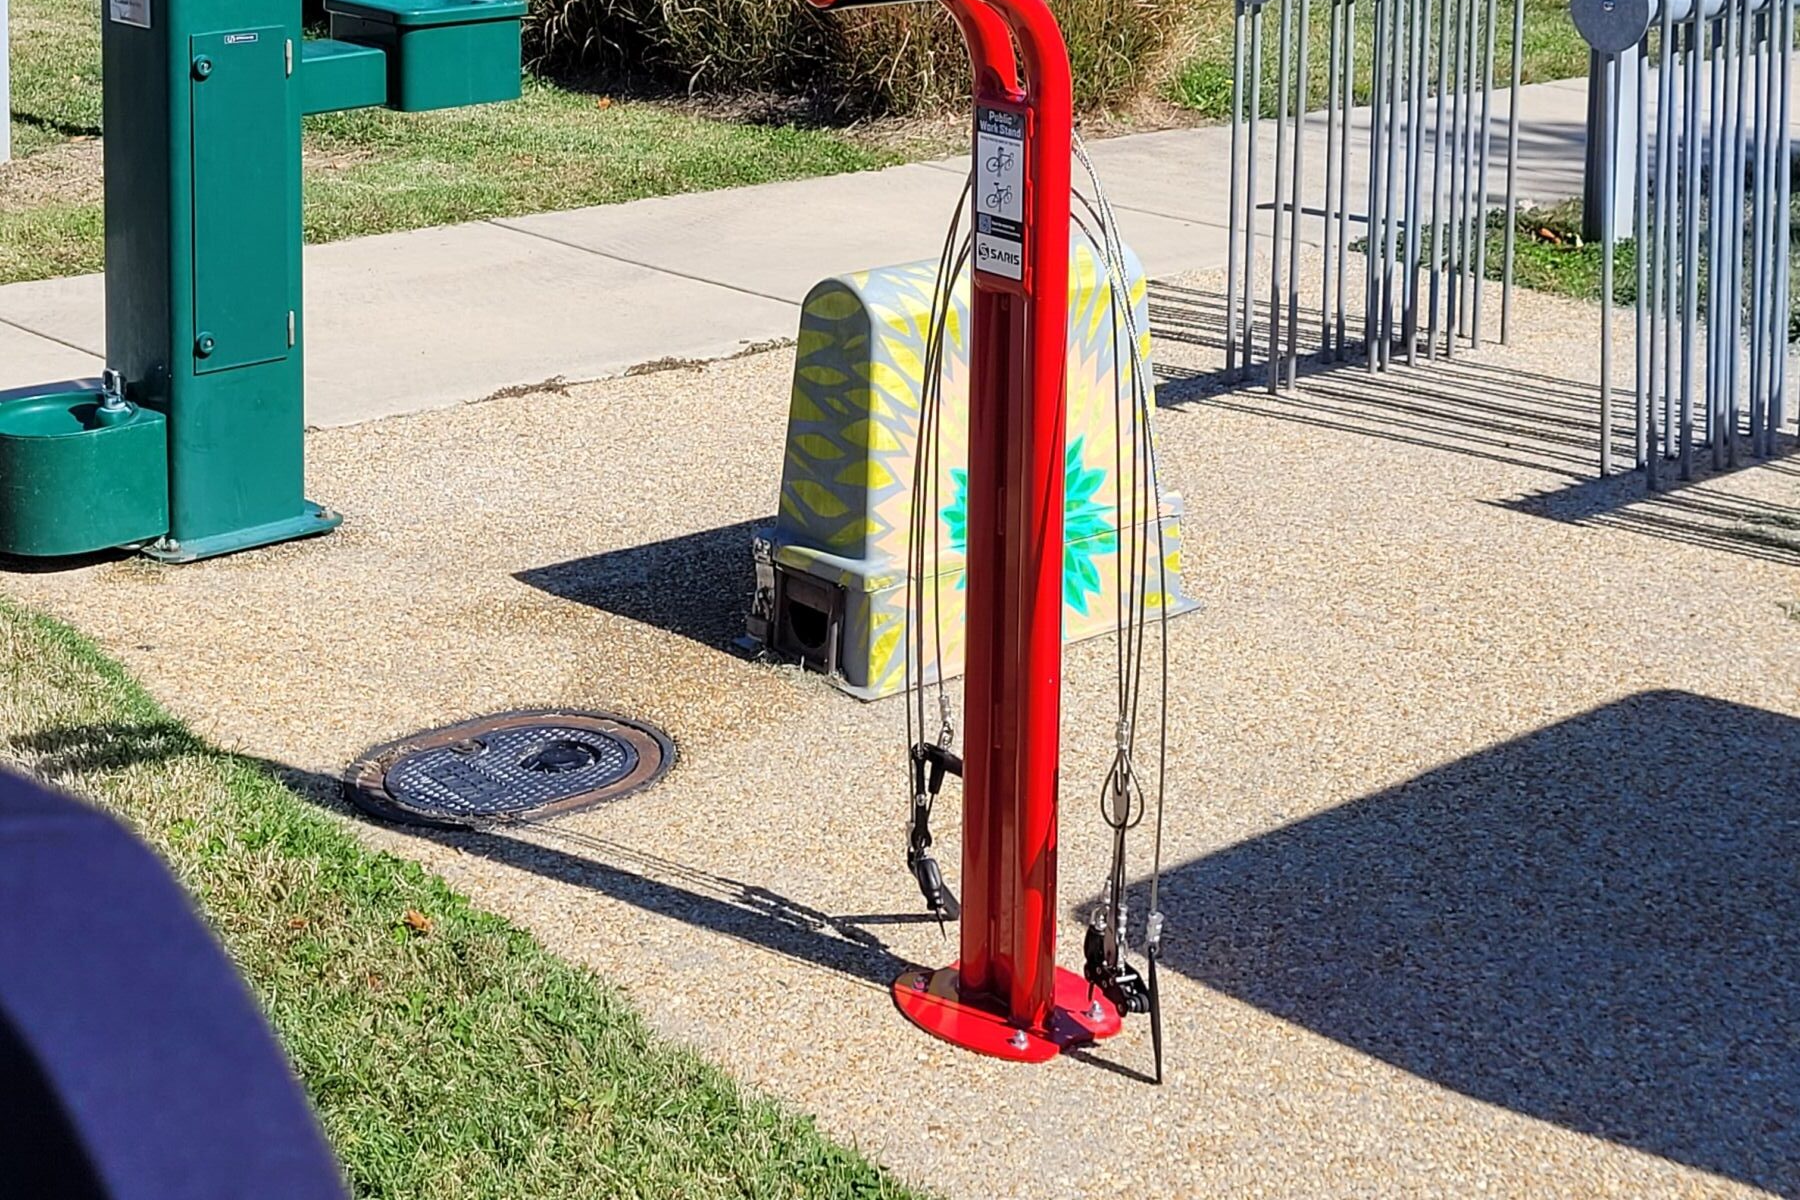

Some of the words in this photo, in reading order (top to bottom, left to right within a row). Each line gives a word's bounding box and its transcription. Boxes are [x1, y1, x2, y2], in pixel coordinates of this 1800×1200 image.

[989, 110, 1012, 125] Public
[979, 119, 999, 134] Work
[999, 124, 1021, 138] Stand
[990, 249, 1020, 265] SARIS
